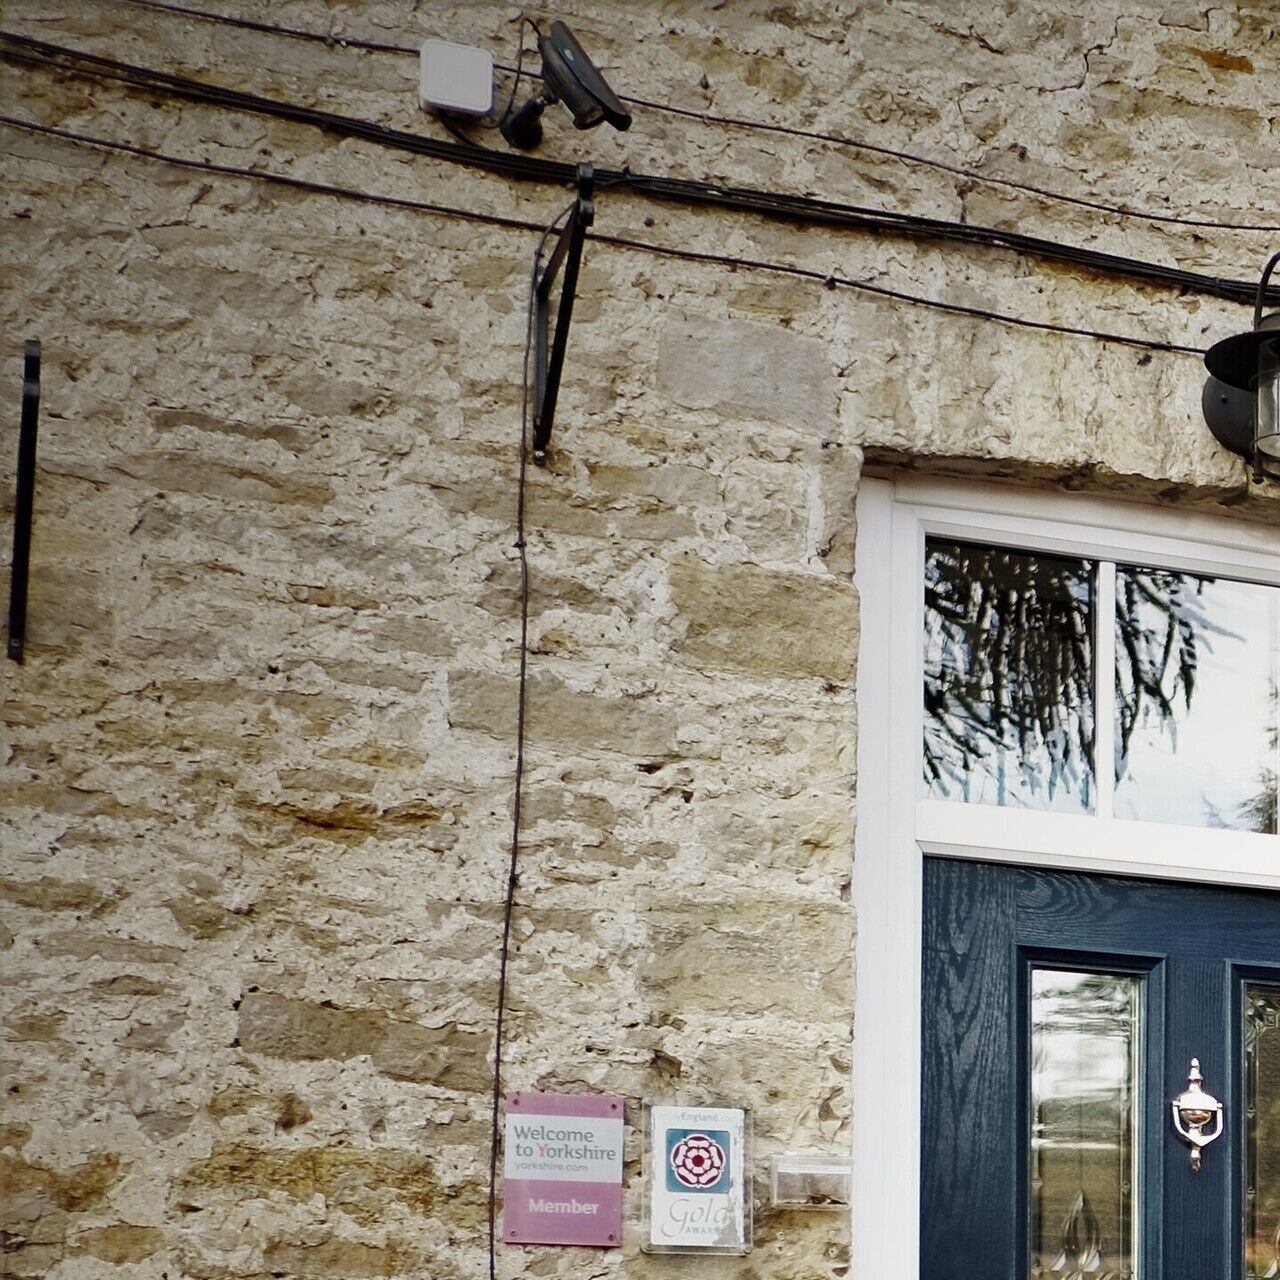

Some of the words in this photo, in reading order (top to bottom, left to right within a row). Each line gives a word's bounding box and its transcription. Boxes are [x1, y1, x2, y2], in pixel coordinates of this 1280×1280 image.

[514, 1125, 594, 1142] Welcome
[515, 1144, 534, 1157] to
[537, 1143, 616, 1160] Yorkshire
[515, 1162, 588, 1172] yorkshire.com
[529, 1198, 599, 1214] Member
